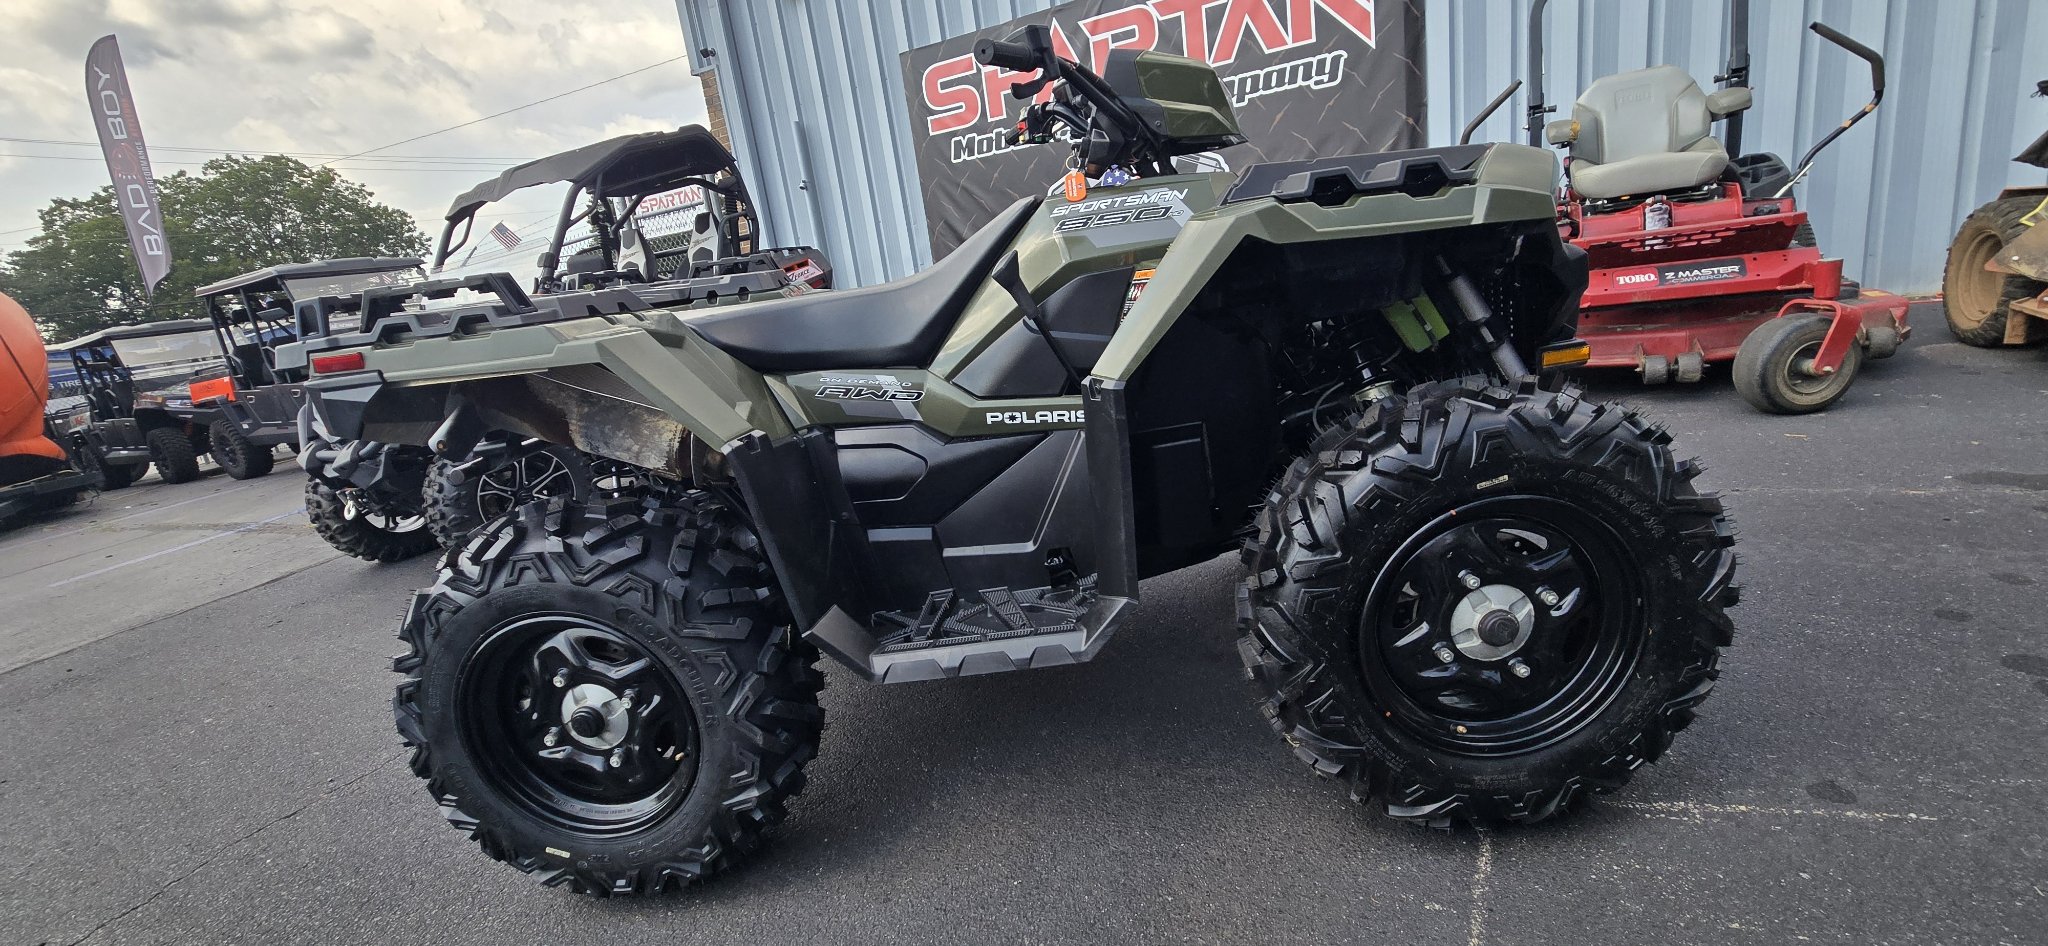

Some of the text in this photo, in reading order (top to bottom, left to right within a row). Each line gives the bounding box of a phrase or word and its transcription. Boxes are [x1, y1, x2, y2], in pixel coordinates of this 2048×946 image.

[1222, 50, 1348, 108] pany
[93, 63, 163, 256] BAD BOY
[639, 186, 703, 213] SPARTAN
[1050, 188, 1189, 218] SPORTSMAN
[1053, 205, 1174, 233] 850
[1665, 272, 1676, 280] Z
[1678, 265, 1740, 278] MASTER
[815, 385, 926, 401] AWD
[847, 378, 912, 387] DEMAND
[985, 409, 1086, 425] POLARIS
